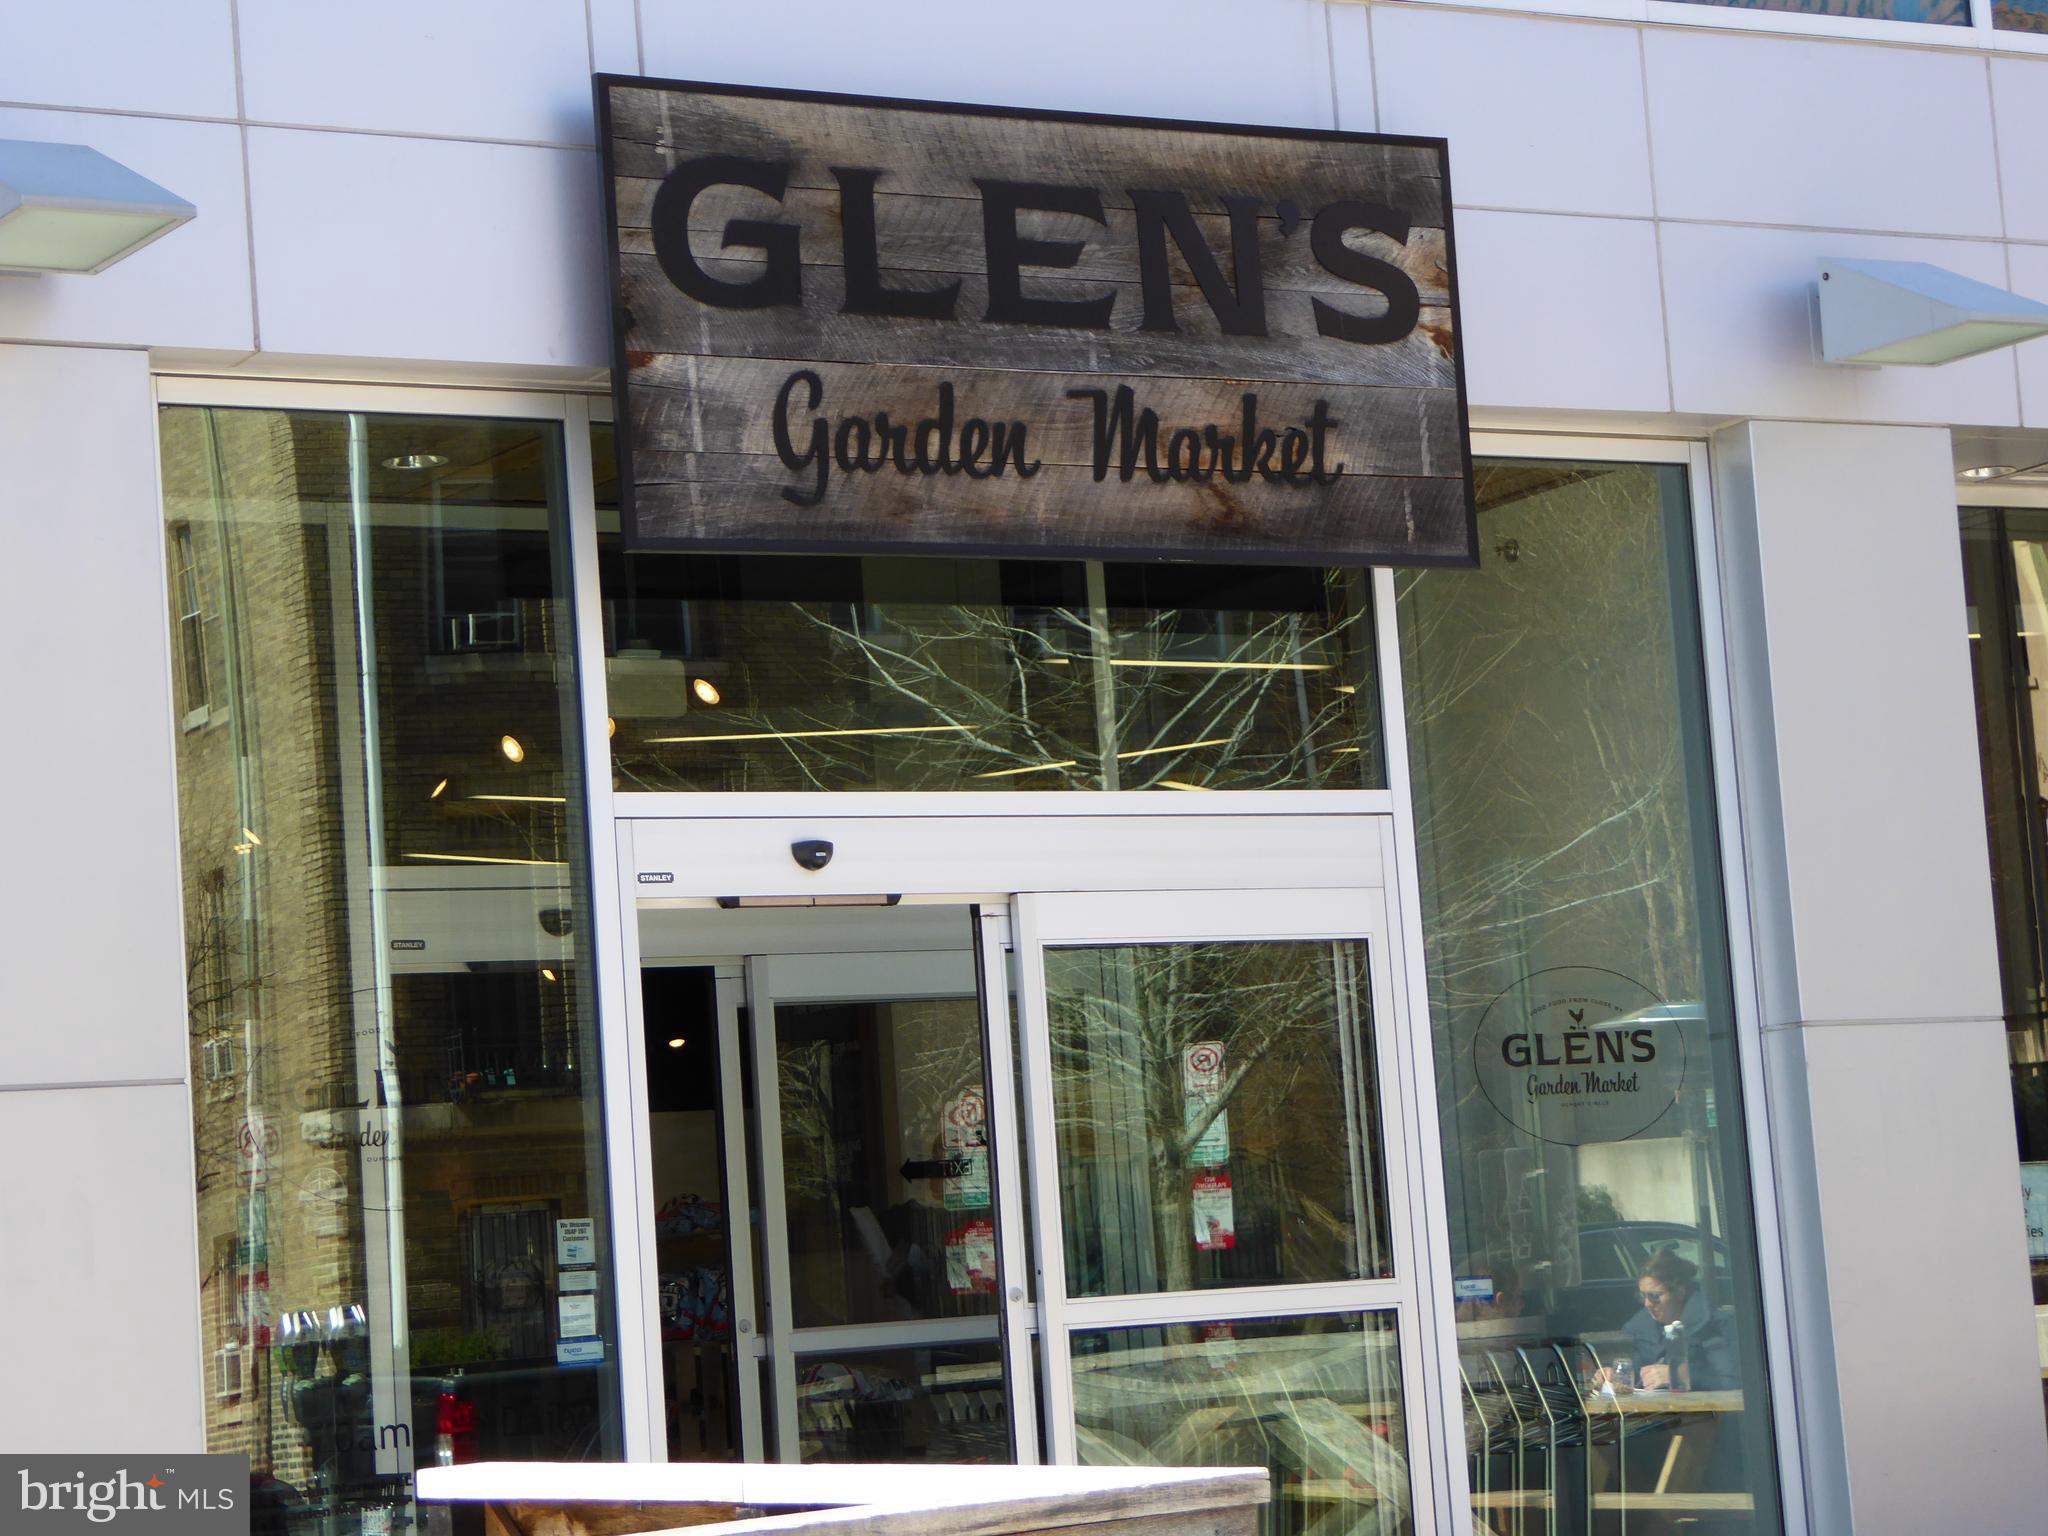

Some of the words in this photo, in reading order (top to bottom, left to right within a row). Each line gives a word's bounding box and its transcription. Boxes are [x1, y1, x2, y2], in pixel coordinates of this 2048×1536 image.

[650, 156, 1420, 345] GLEN'S
[772, 370, 1040, 506] Garden
[1067, 383, 1343, 487] Market
[640, 874, 672, 882] STANLEY
[1501, 1029, 1656, 1067] GLEN'S
[1527, 1073, 1581, 1104] Garden
[1580, 1070, 1641, 1094] Market
